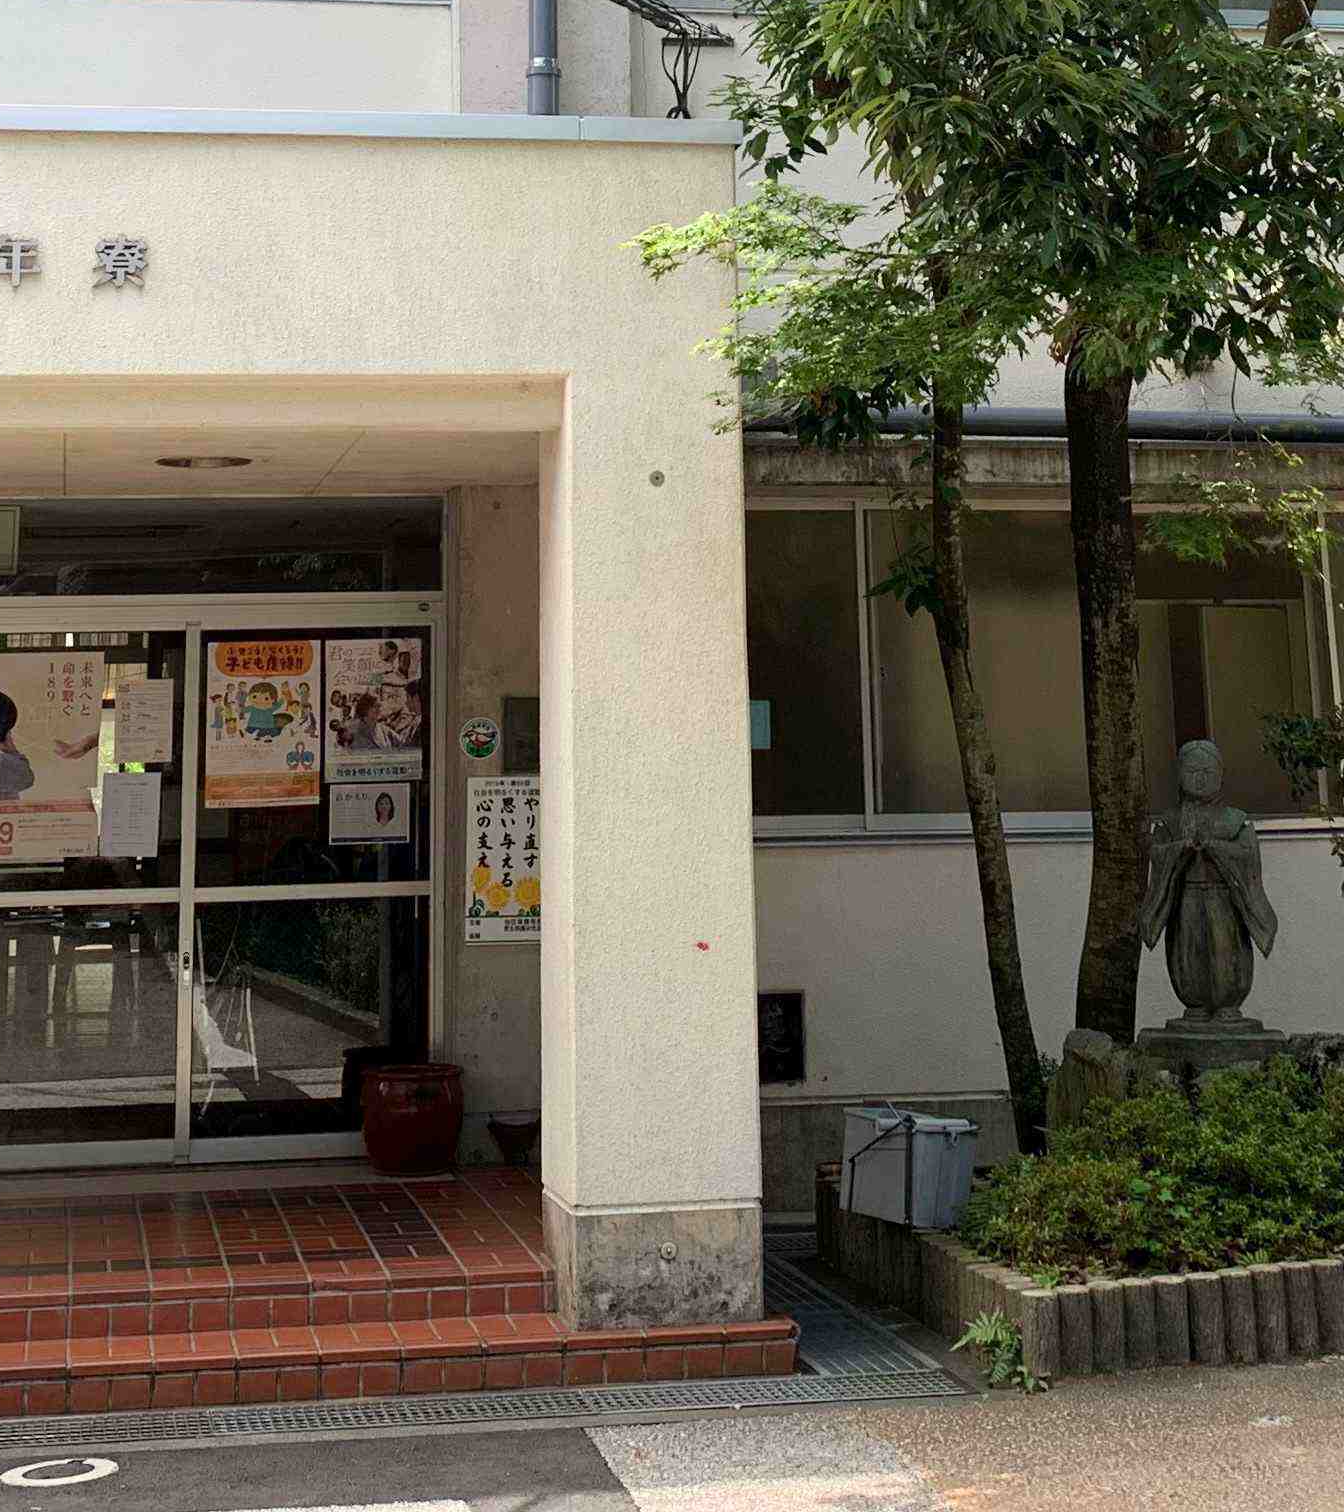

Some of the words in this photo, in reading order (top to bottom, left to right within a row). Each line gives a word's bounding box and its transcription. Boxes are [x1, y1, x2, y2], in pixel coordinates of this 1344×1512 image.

[79, 662, 95, 717] 未来へと
[476, 798, 493, 869] 心の支え
[523, 797, 540, 869] やり直す
